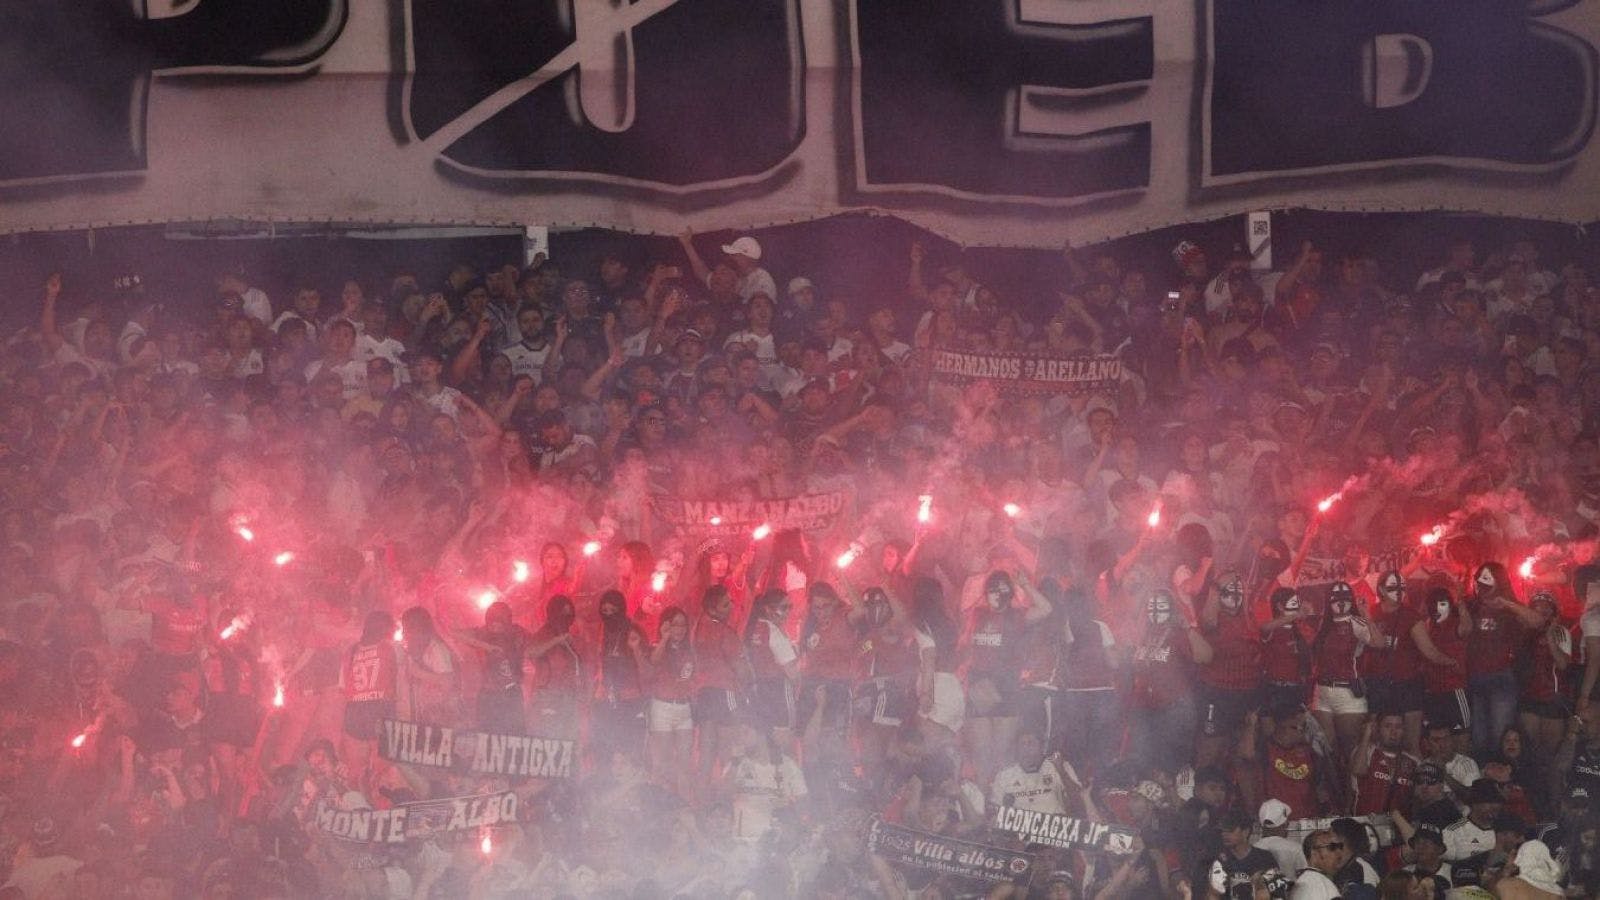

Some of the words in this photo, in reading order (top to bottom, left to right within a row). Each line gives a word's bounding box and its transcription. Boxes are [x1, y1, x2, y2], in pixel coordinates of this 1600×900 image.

[1034, 359, 1121, 382] ARELLANO
[382, 719, 453, 768] VILLA
[472, 732, 575, 778] ANTIGXA
[315, 798, 406, 843] MONTE
[447, 791, 518, 831] ALBO
[995, 805, 1082, 843] ACONCAGXA
[914, 839, 954, 861] Villa
